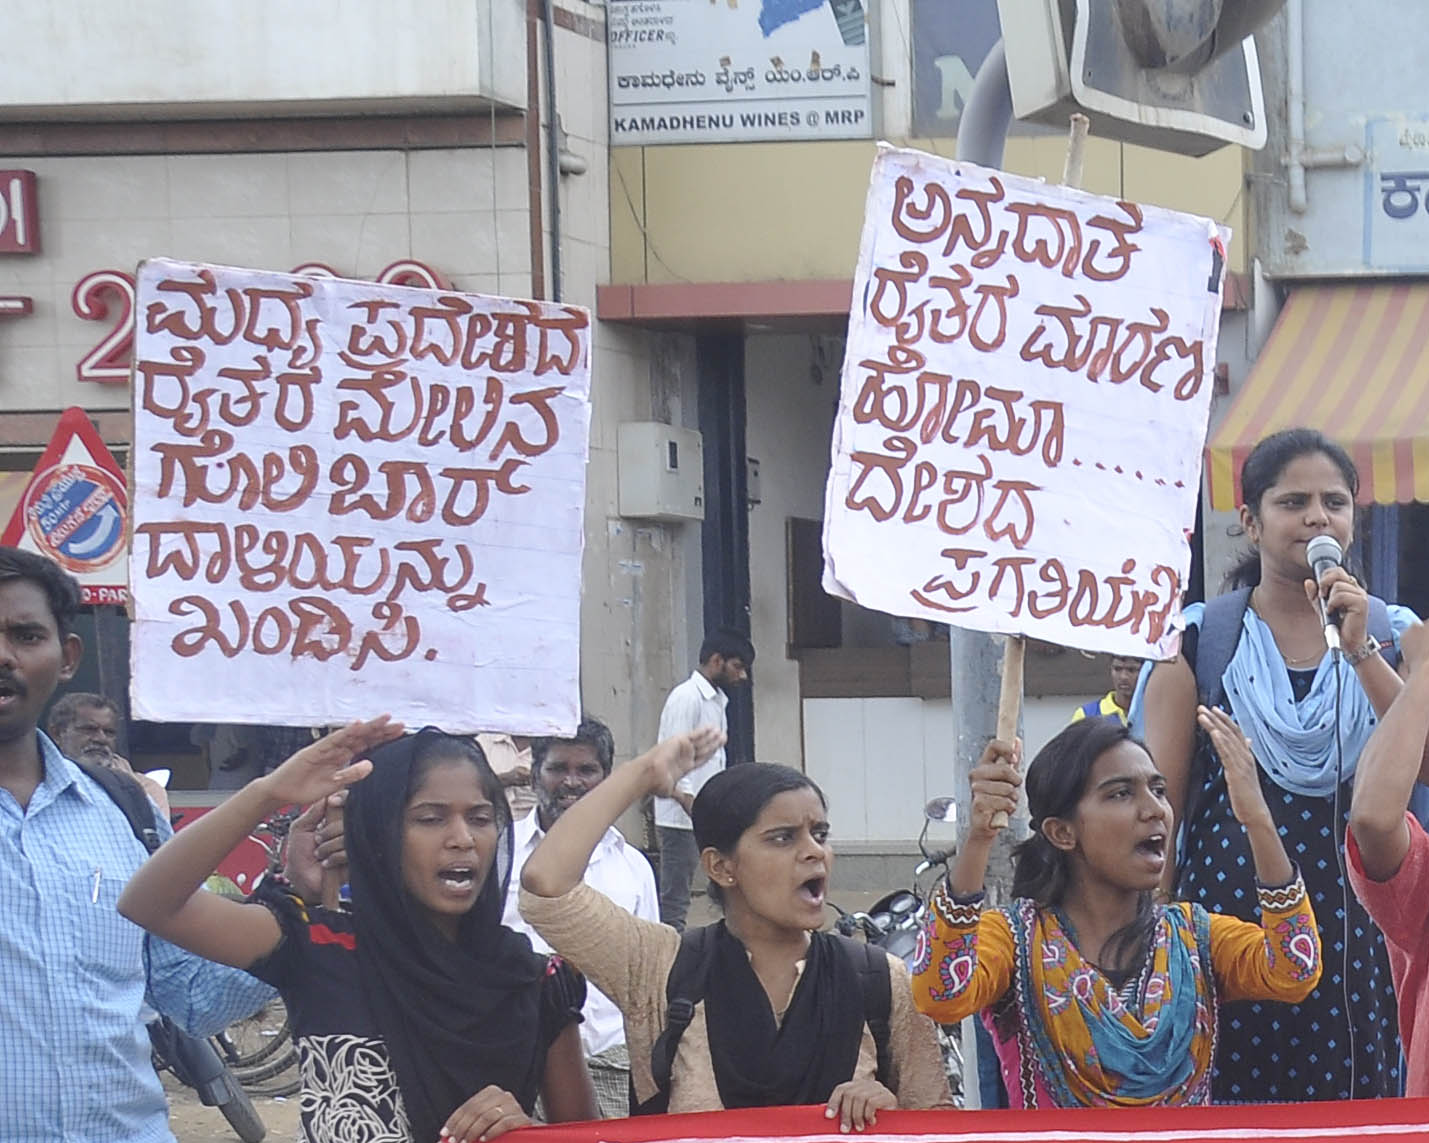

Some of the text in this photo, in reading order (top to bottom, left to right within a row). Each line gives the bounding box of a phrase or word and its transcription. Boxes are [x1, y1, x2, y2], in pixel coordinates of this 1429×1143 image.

[614, 109, 866, 133] KAMADHENU WINES @ MRP
[869, 250, 1019, 351] ರೈತರ
[137, 346, 567, 462] ರೈತರ ಮೇಲಿನ
[845, 436, 1044, 550] ದೇಶದ
